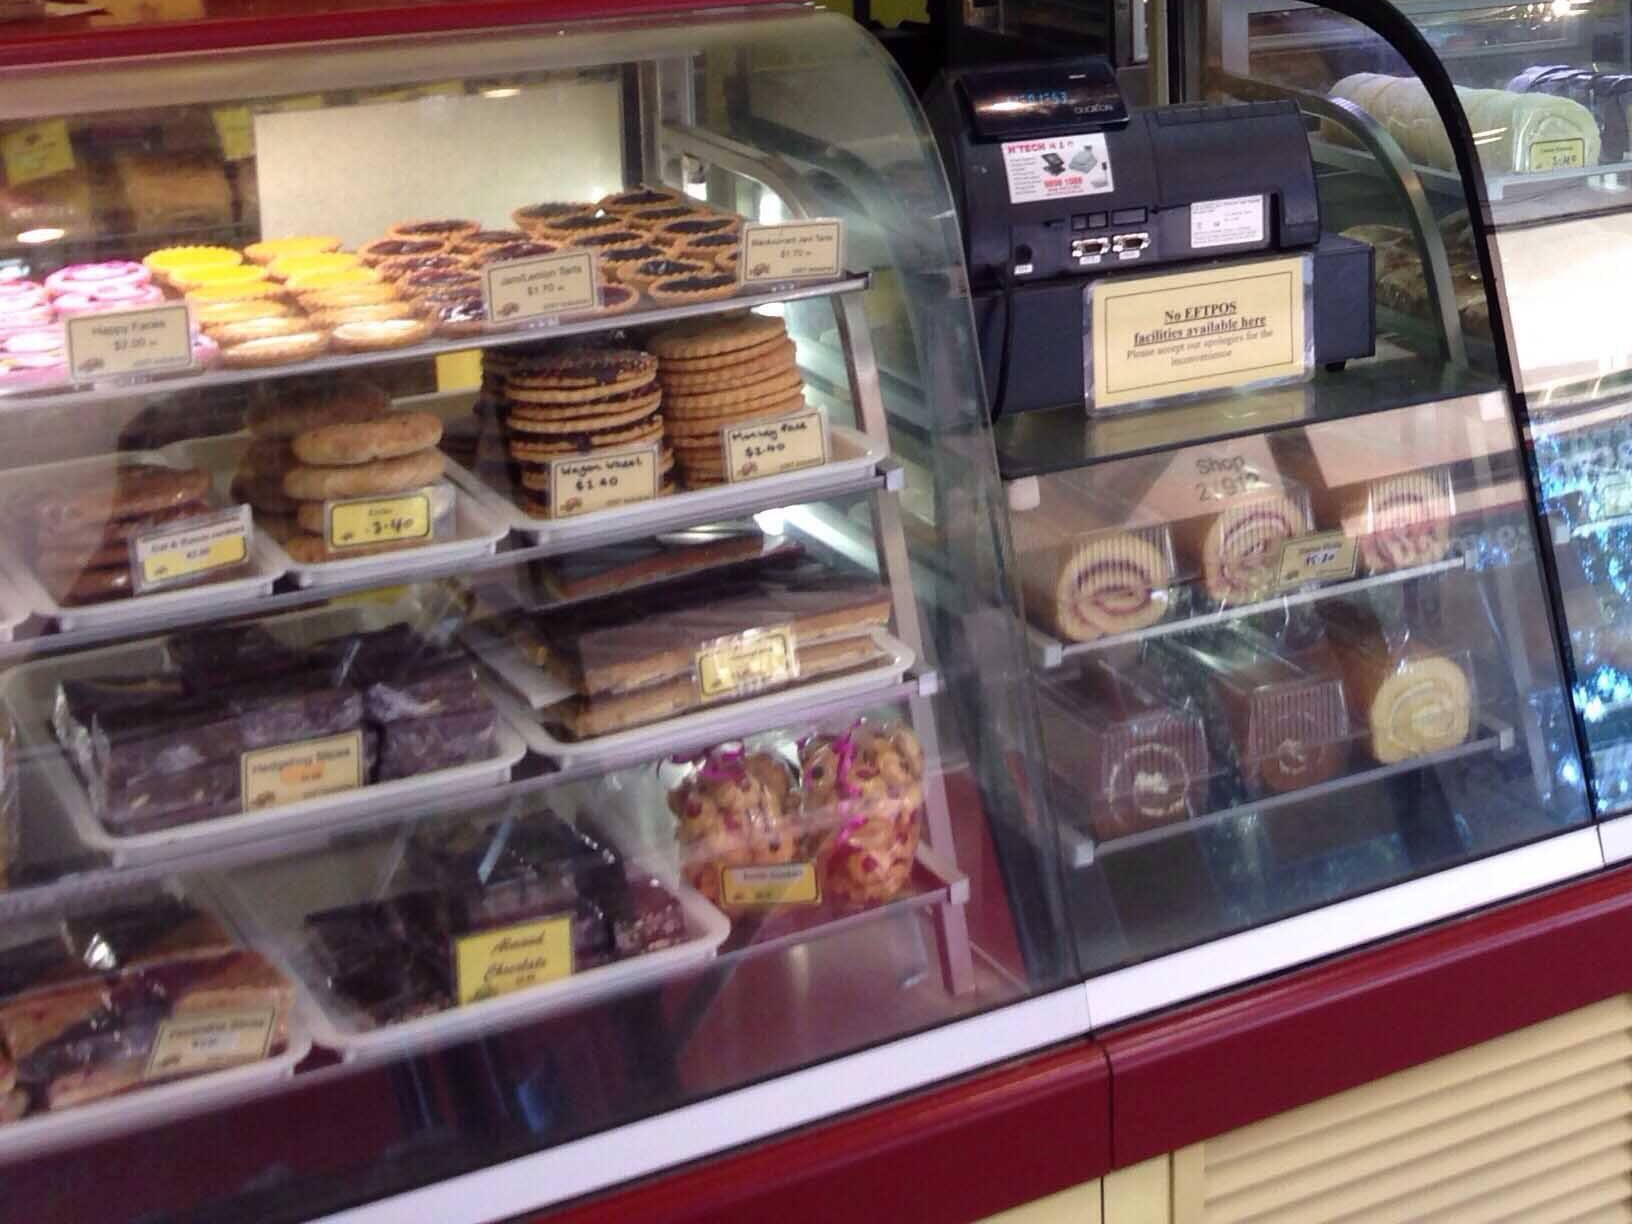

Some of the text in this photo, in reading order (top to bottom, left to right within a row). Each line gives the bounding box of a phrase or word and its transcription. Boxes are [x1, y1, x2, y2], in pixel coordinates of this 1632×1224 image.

[1164, 301, 1237, 322] No EFTPOS
[1133, 314, 1267, 346] facilities available here
